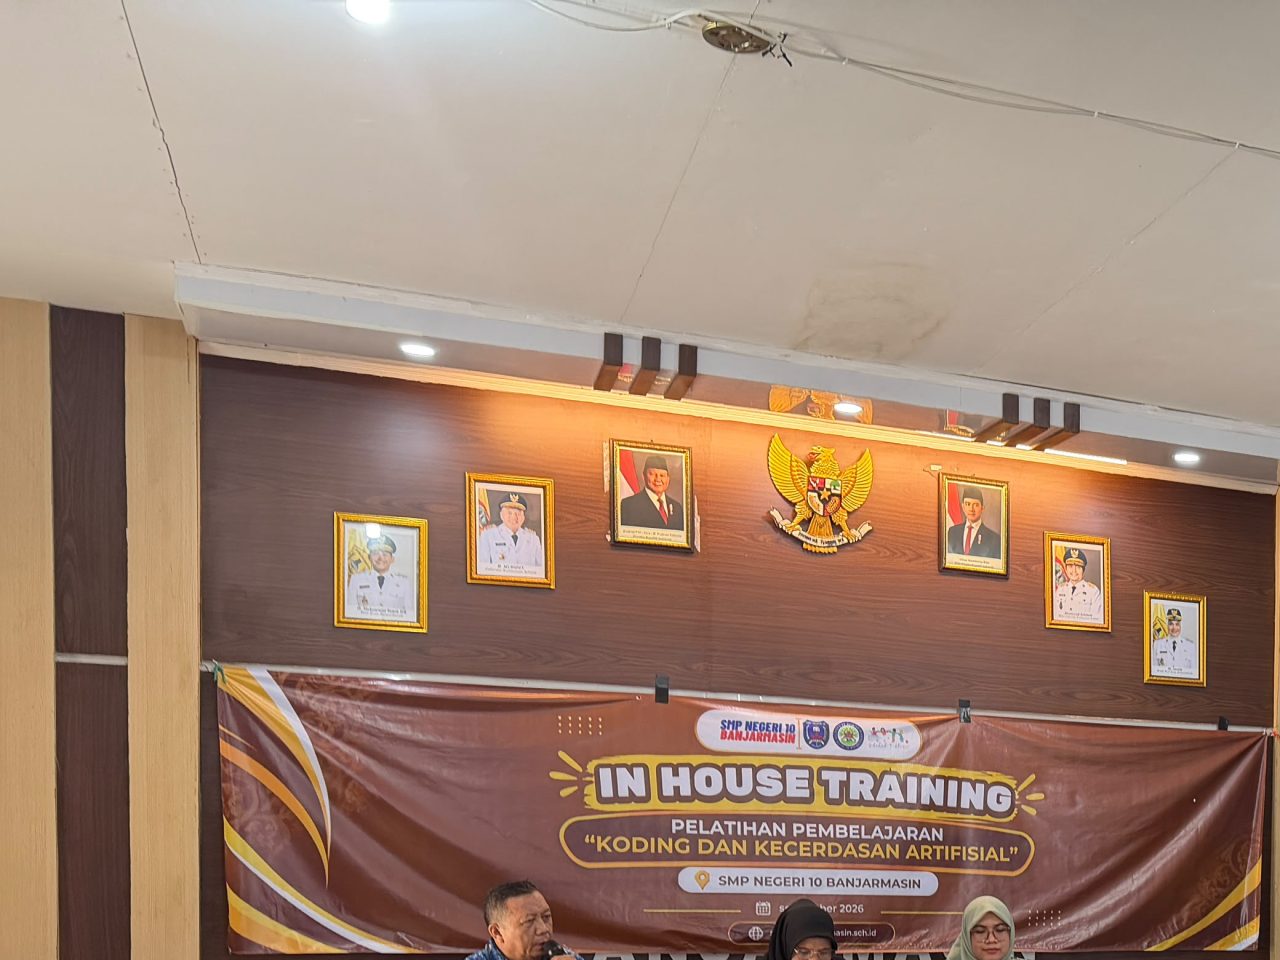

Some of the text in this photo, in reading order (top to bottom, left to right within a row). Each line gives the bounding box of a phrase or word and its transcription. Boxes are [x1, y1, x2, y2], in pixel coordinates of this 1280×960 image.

[720, 719, 743, 731] SMP
[744, 721, 783, 733] NEGERI
[785, 723, 796, 733] 10
[720, 729, 796, 744] BANJARMASIN
[599, 766, 1012, 813] IN HOUSE TRAINING
[671, 818, 944, 842] PELATIHAN PEMBELAJARAN
[698, 838, 747, 856] DAN
[754, 840, 900, 860] KECERDASAN
[718, 875, 922, 889] SMP NEGERI 10 BANJARMASIN
[839, 904, 865, 913] 2026
